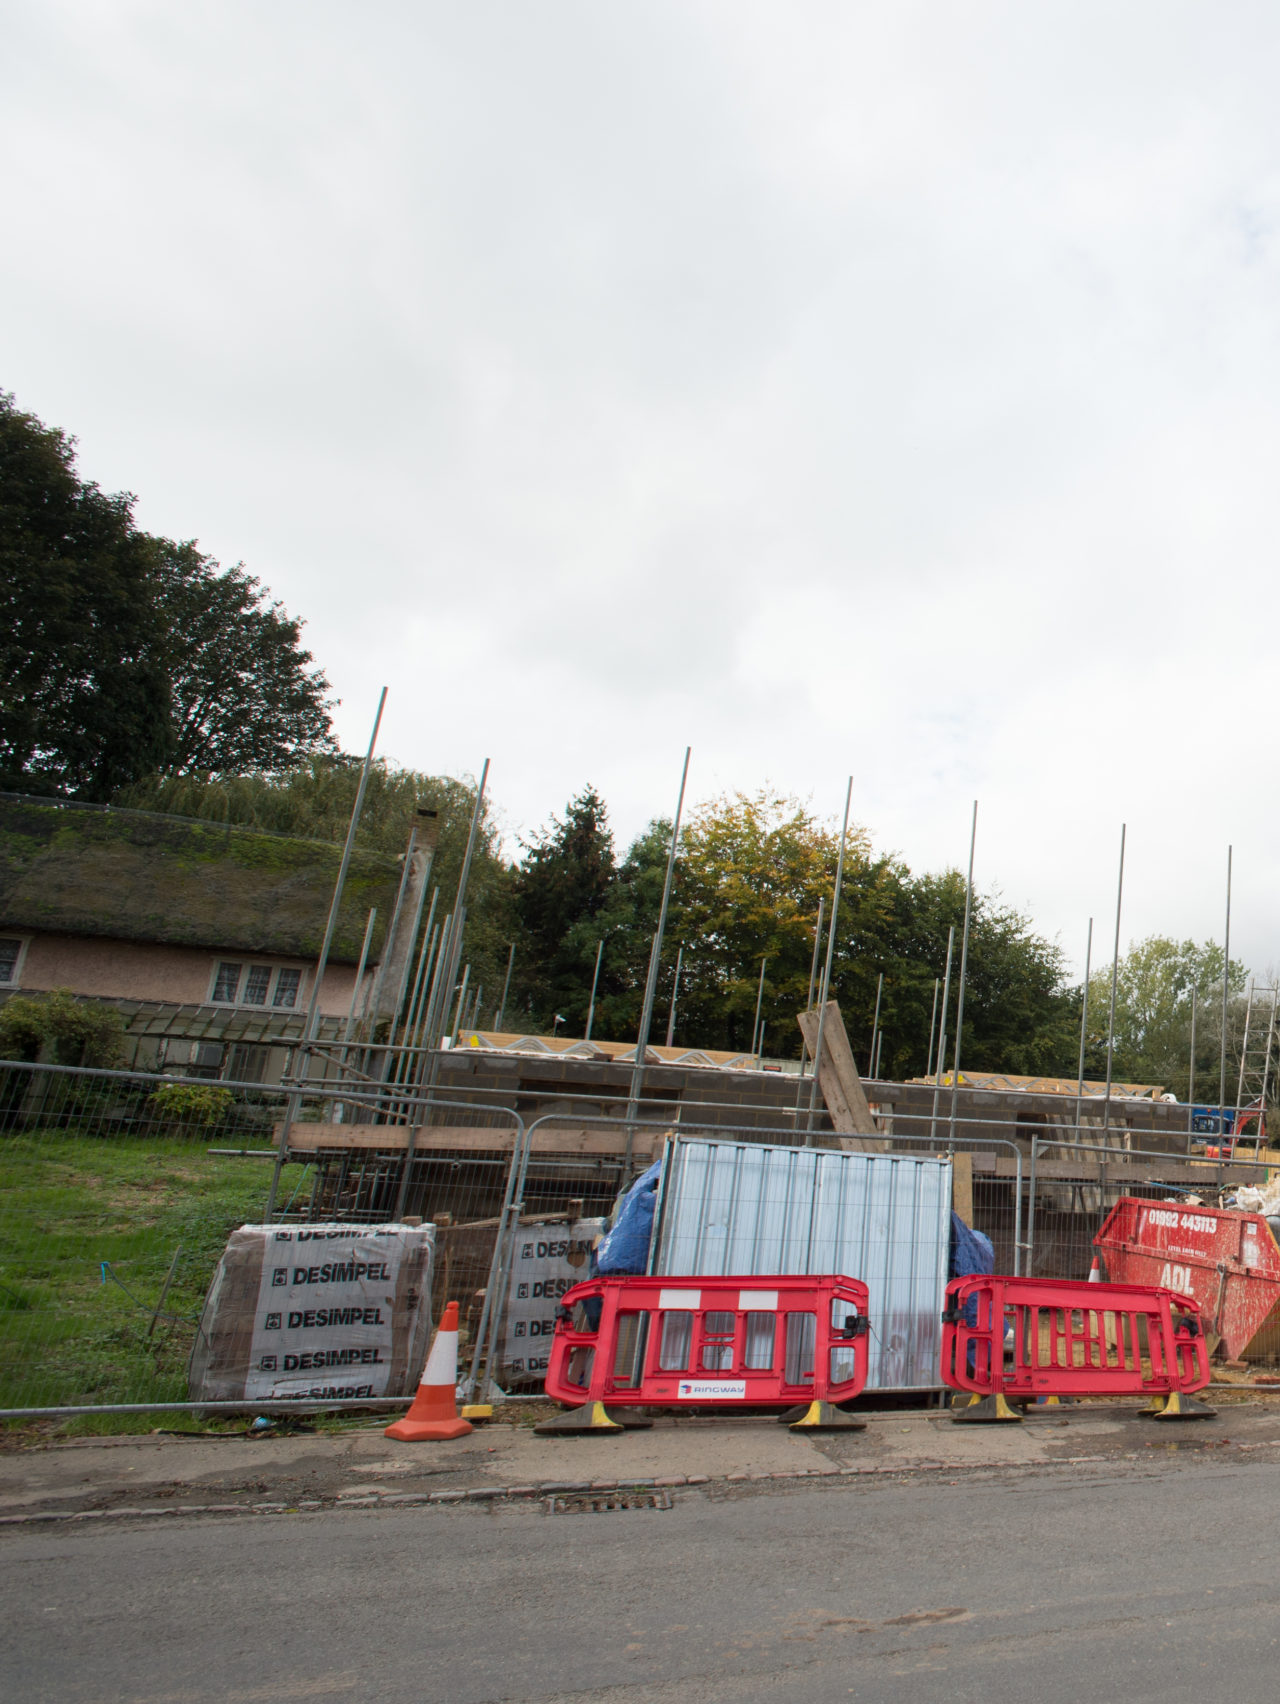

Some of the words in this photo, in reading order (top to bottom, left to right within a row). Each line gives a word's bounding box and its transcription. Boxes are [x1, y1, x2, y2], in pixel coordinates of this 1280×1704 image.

[1148, 1209, 1179, 1228] 01992
[1181, 1213, 1218, 1233] 443113
[292, 1262, 392, 1286] DESIMPEL
[1160, 1263, 1195, 1296] ADL
[288, 1308, 385, 1329] DESIMPEL
[283, 1348, 384, 1371] DESIMPEL
[694, 1386, 745, 1394] RINGWAY
